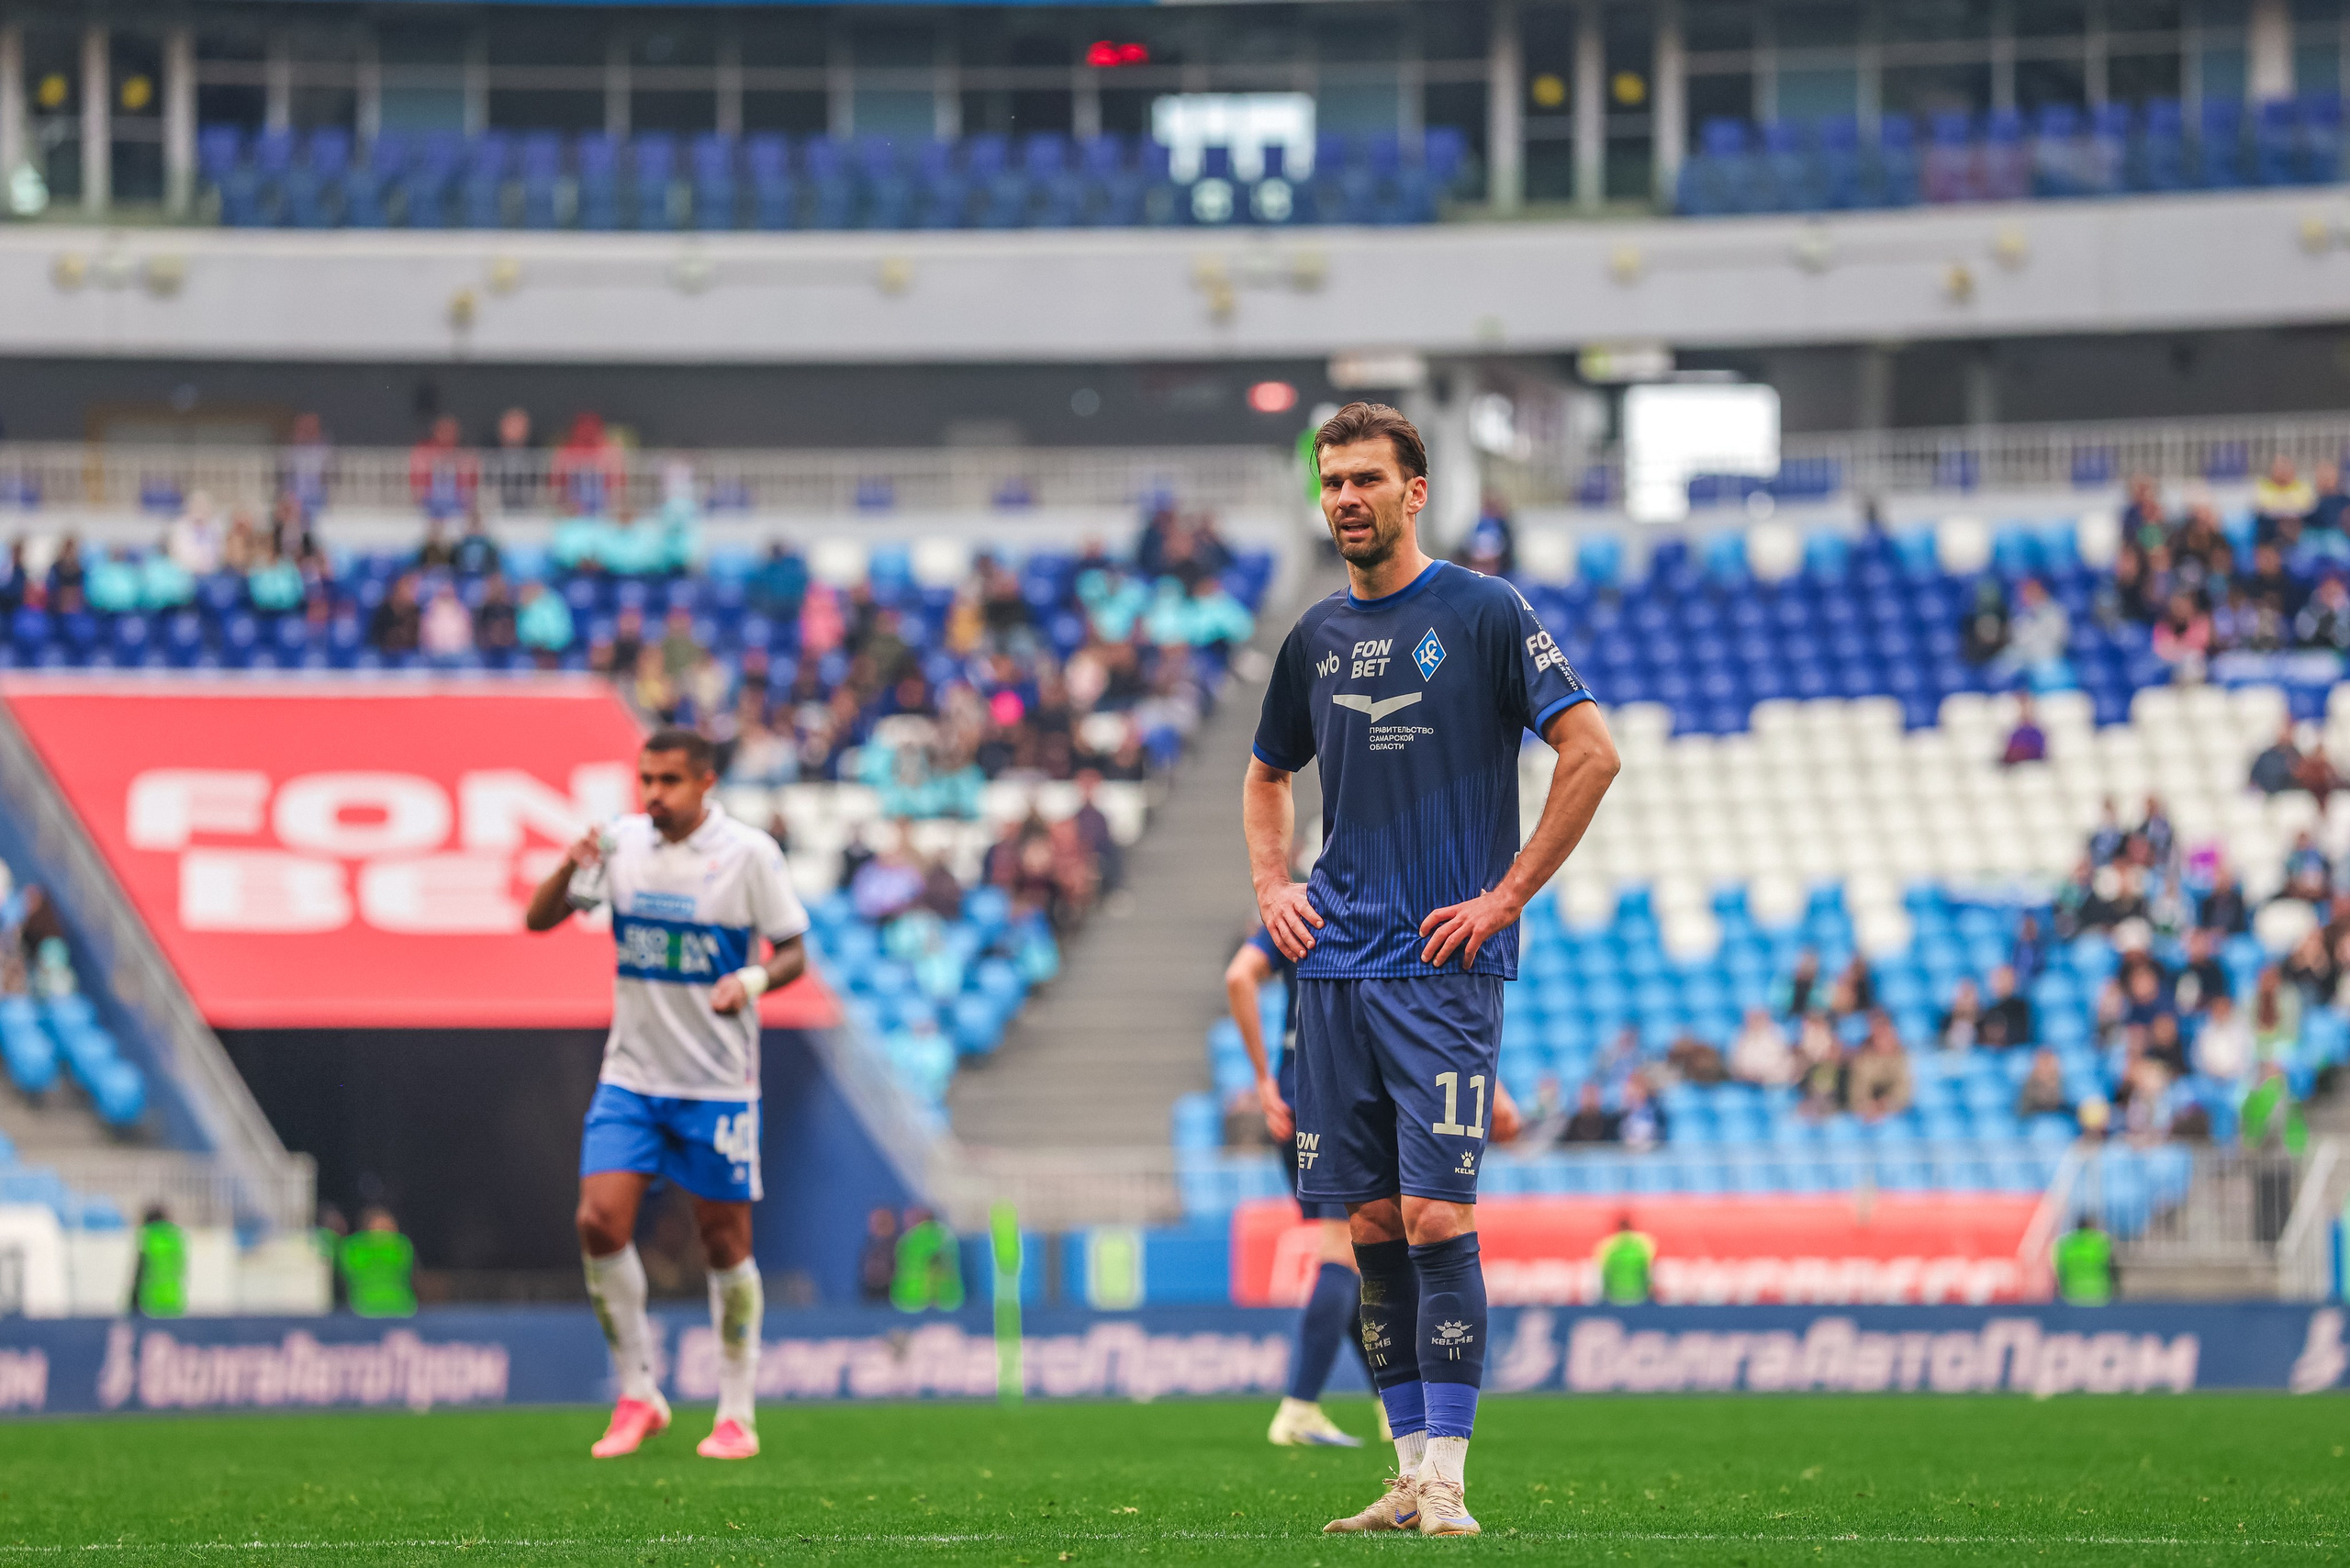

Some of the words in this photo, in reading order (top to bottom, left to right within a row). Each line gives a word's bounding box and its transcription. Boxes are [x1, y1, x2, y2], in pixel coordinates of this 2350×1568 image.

[1351, 639, 1393, 659] FON
[1526, 631, 1553, 657] FO
[1316, 651, 1340, 678] wb
[1351, 658, 1391, 679] BET
[1535, 647, 1566, 673] BE
[1370, 726, 1435, 734] ПРАВИТЕЛЬСТВО
[1370, 734, 1415, 743] САМАРСКОЙ
[1370, 743, 1404, 751] ОБЛАСТИ
[127, 762, 634, 857] FON
[1433, 1071, 1485, 1139] 11
[1296, 1131, 1320, 1151] ON
[1298, 1151, 1319, 1170] ET
[1454, 1167, 1475, 1176] KELME
[1431, 1335, 1473, 1347] KELME
